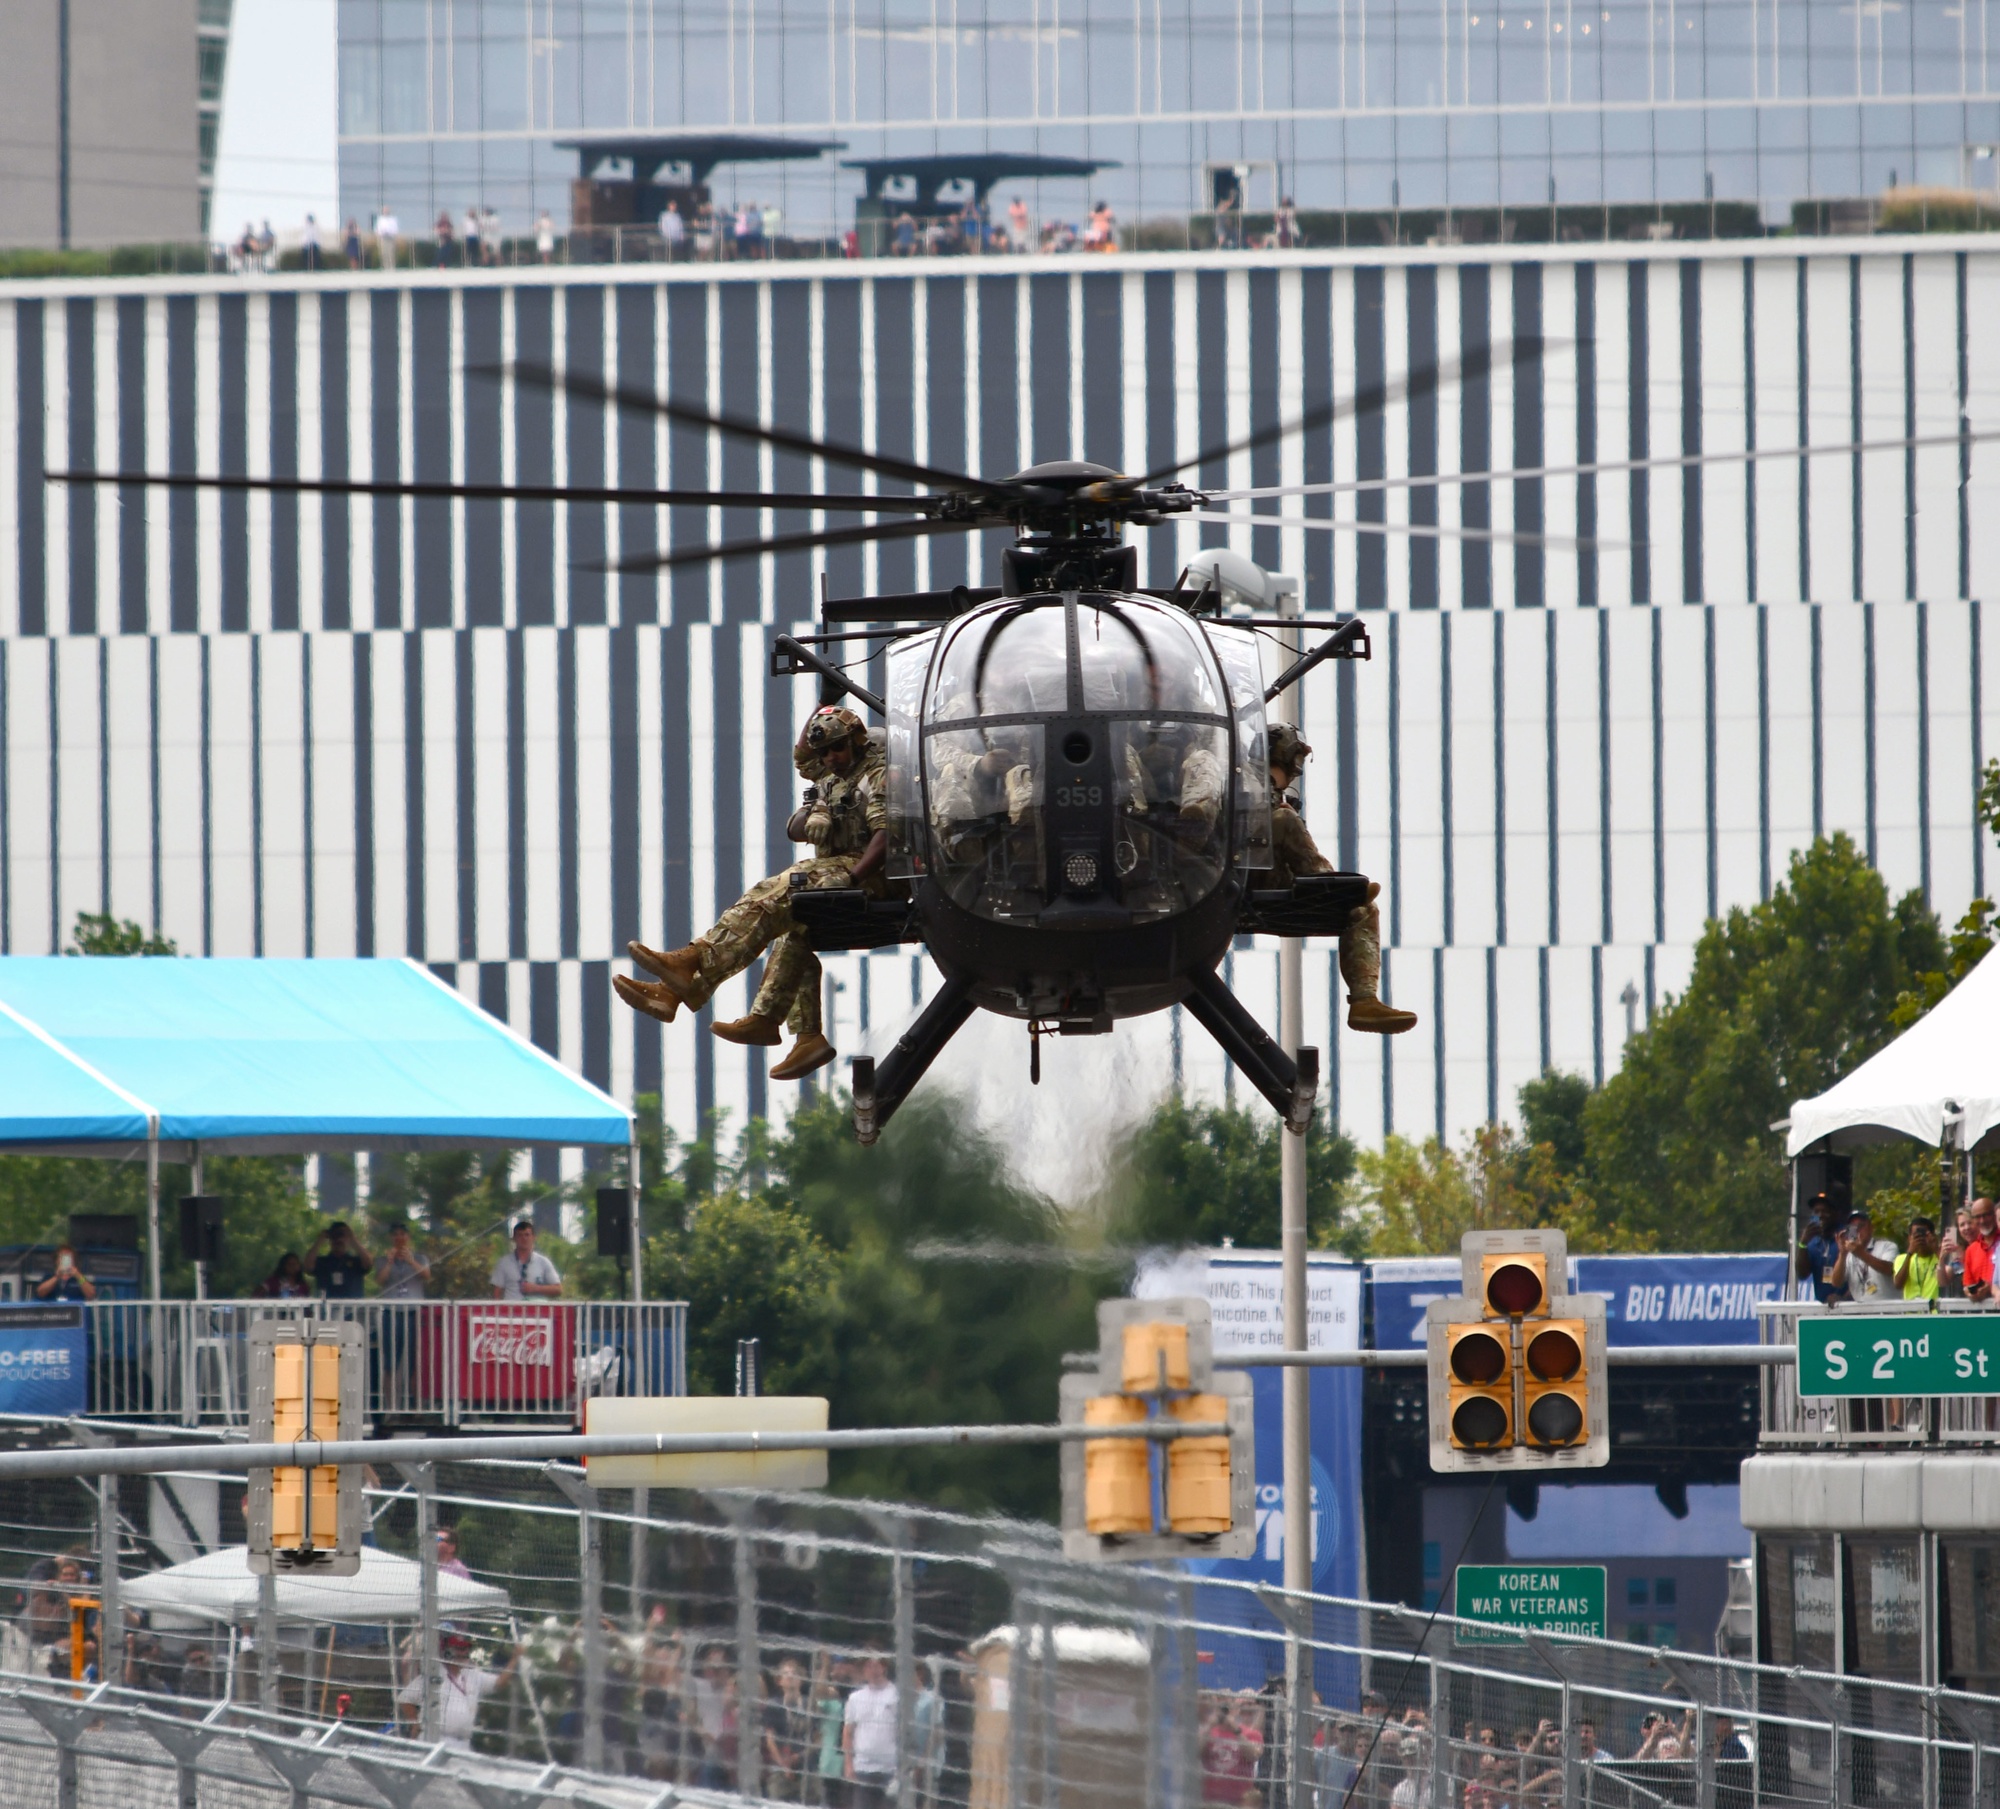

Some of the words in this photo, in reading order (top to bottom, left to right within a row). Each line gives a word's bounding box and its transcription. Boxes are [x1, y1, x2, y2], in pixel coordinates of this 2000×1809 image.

[1056, 786, 1102, 807] 359
[1248, 1281, 1275, 1300] This
[1626, 1286, 1665, 1321] BIG
[1335, 1307, 1346, 1323] is
[1824, 1340, 1849, 1380] S
[1872, 1334, 1929, 1379] 2nd
[1954, 1348, 1989, 1378] St
[1500, 1574, 1560, 1591] KOREAN
[1472, 1598, 1502, 1615] WAR
[1510, 1598, 1589, 1615] VETERANS
[1543, 1621, 1600, 1638] BRIDGE
